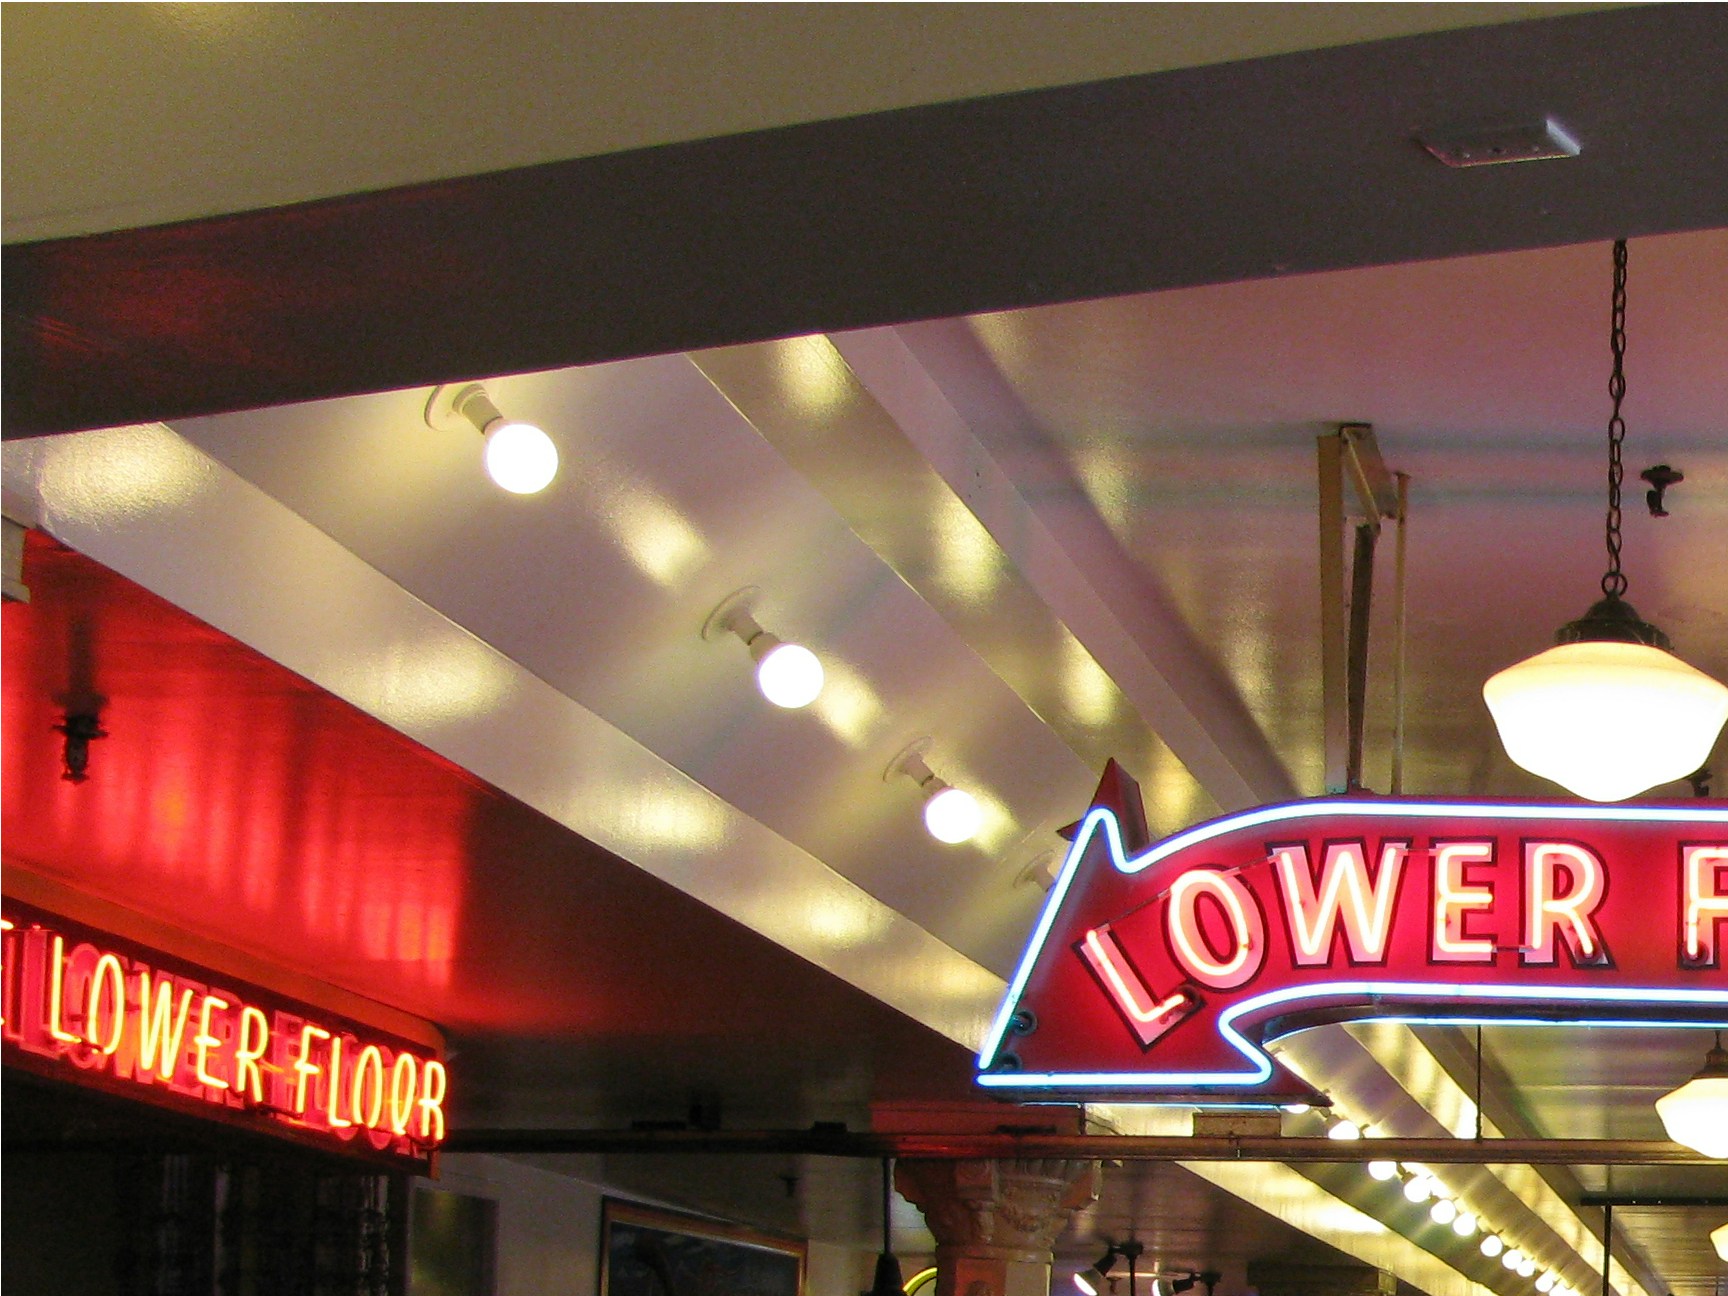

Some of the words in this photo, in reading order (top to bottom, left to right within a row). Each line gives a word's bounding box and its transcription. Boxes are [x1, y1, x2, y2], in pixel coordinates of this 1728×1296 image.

[49, 935, 269, 1102] LOWER
[293, 1024, 447, 1141] FLOOR
[1076, 839, 1613, 1049] LOWER
